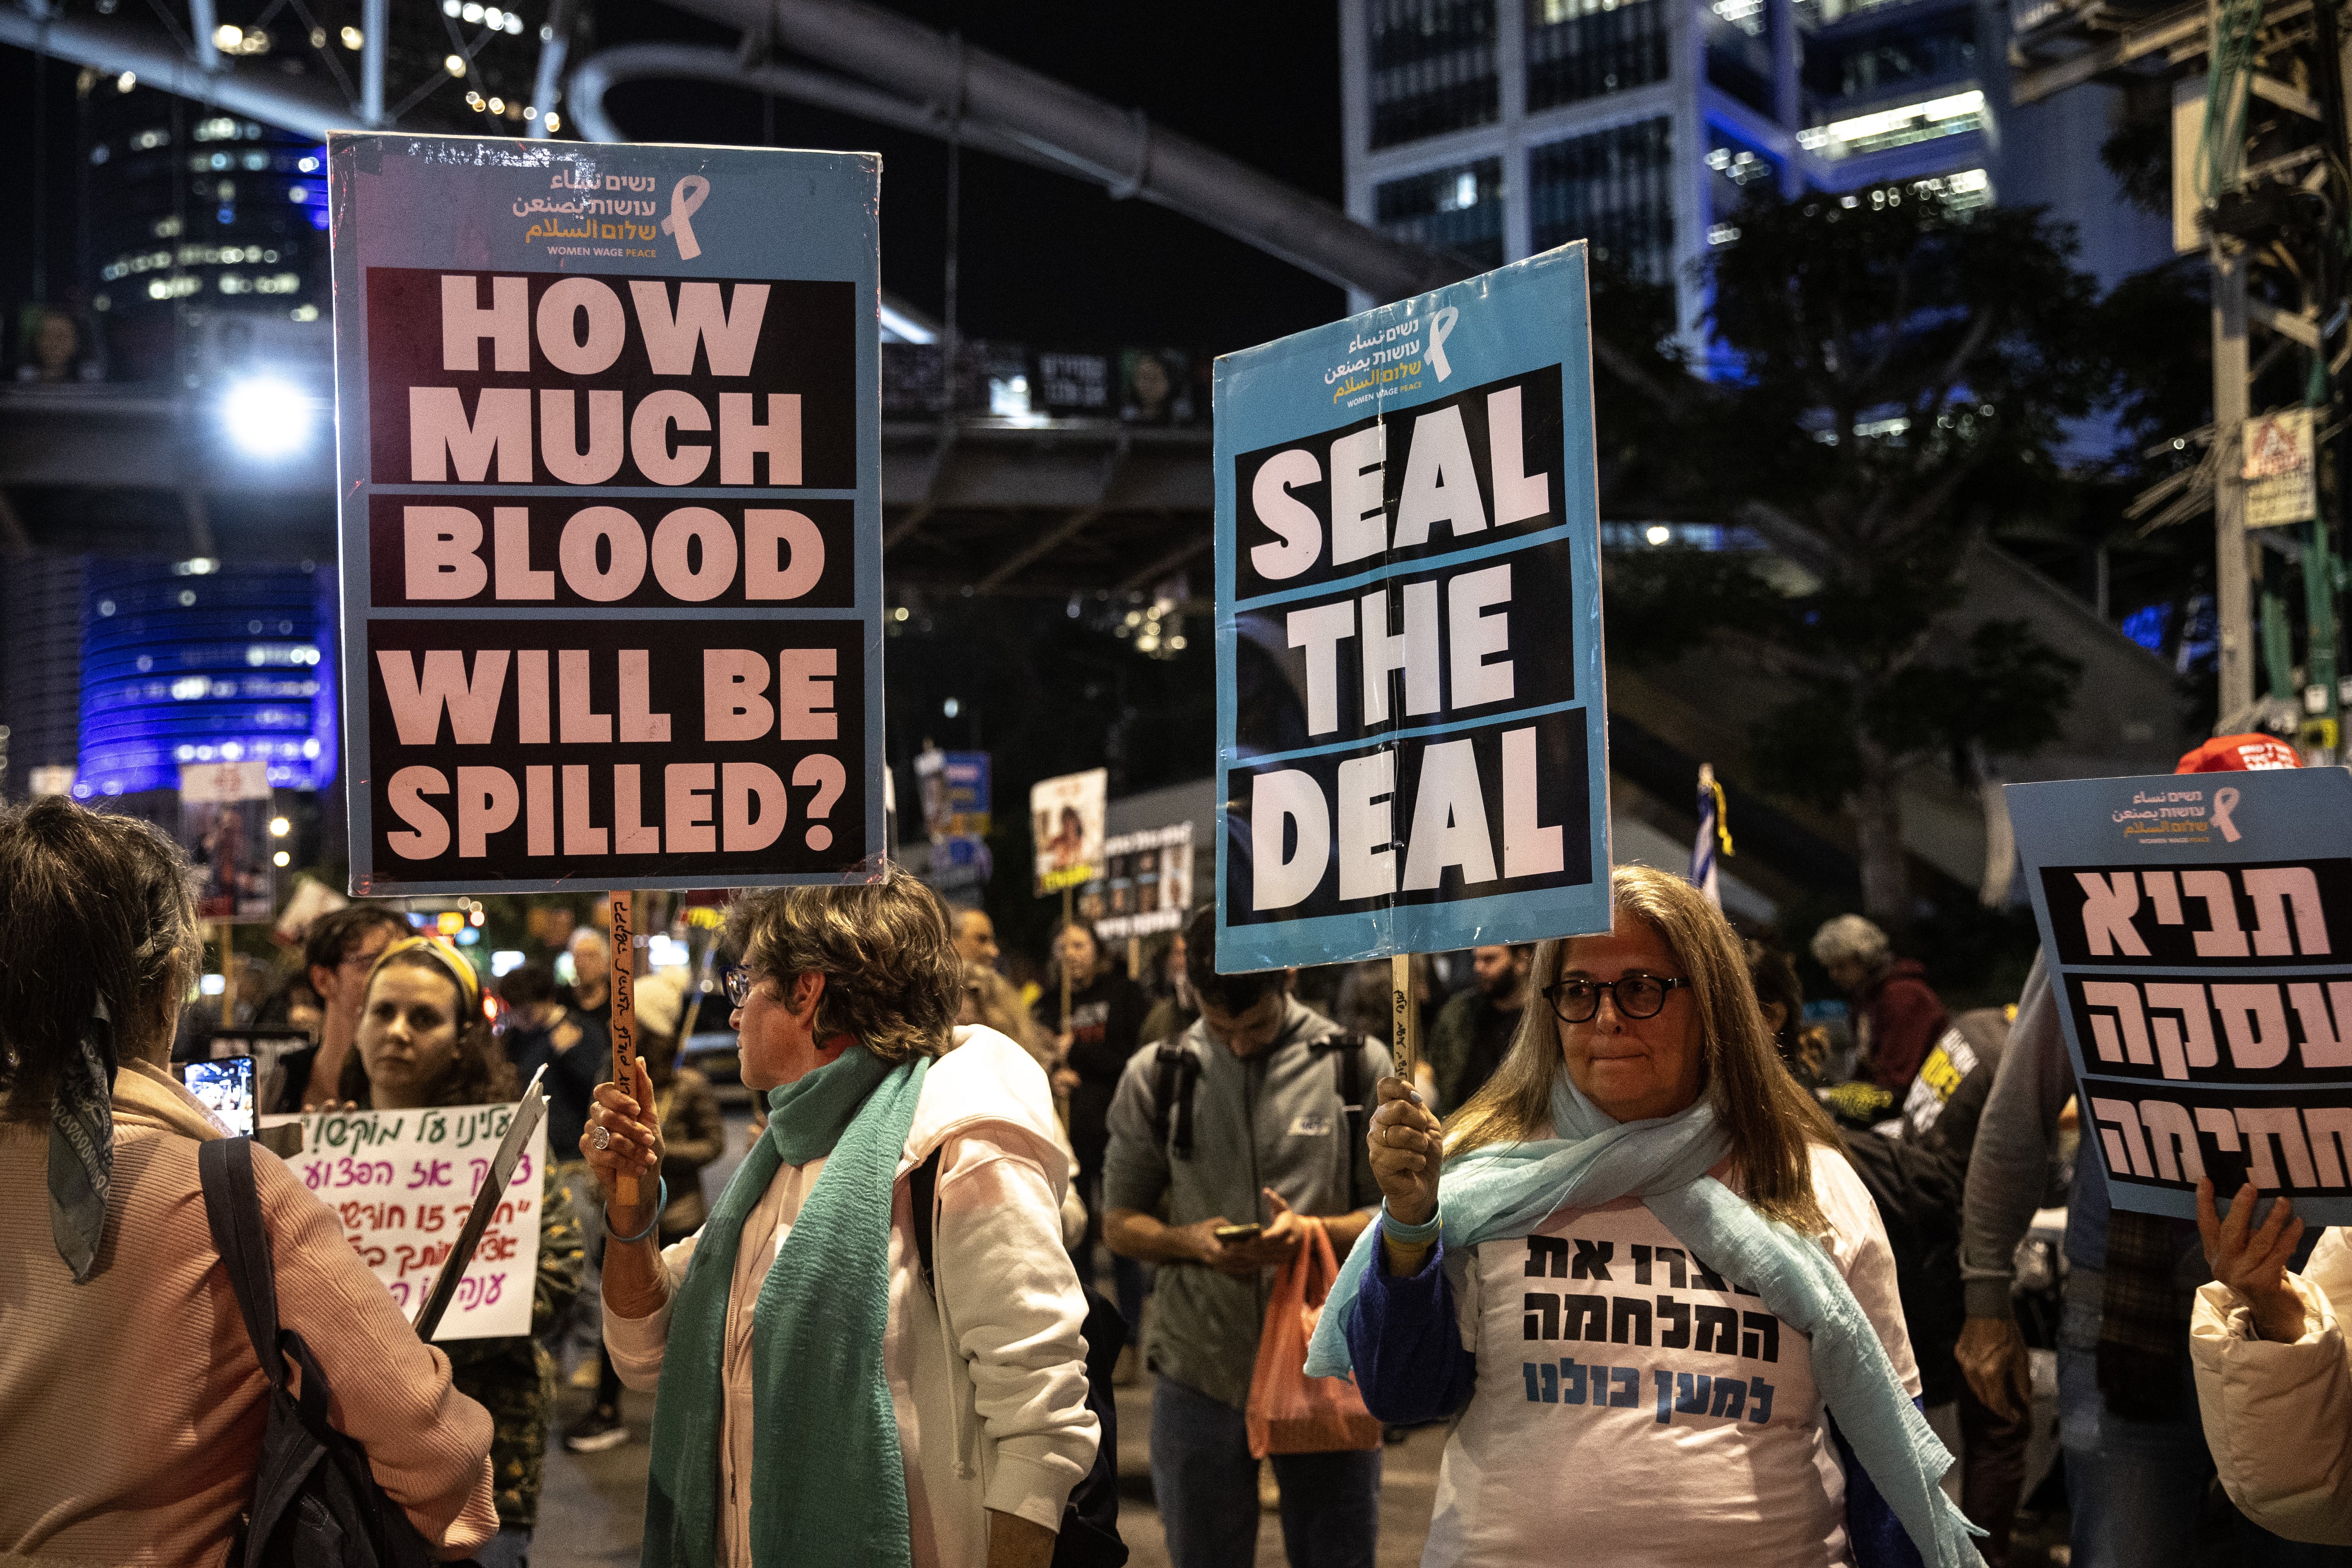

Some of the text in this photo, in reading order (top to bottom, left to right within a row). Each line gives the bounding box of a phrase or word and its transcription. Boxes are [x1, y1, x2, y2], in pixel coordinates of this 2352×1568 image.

[512, 196, 656, 220] עושות يصنعن
[605, 175, 656, 192] נשים
[525, 218, 656, 244] שלום السلام
[547, 246, 656, 258] WOMEN WAGE PEACE
[441, 274, 771, 376] HOW
[1348, 318, 1419, 354] נשים نساء
[1324, 339, 1420, 385] עושות يصنعن
[1333, 360, 1422, 405] שלום السلام
[1347, 381, 1422, 408] WOMEN WAGE PEACE
[409, 386, 803, 486] MUCH
[1250, 385, 1549, 580] SEAL
[403, 505, 825, 602] BLOOD
[1287, 564, 1514, 736] THE
[376, 648, 838, 745] WILL BE
[387, 753, 847, 860] SPILLED?
[1252, 726, 1564, 911] DEAL
[2073, 867, 2332, 957] תביא
[2082, 980, 2352, 1081] עסקה
[416, 1110, 446, 1143] על
[303, 1154, 532, 1196] צק אז הפצוע
[416, 1203, 445, 1233] 15
[1524, 1234, 1614, 1281] את
[1523, 1292, 1779, 1363] המלחמה
[1523, 1357, 1775, 1424] למען כולנו
